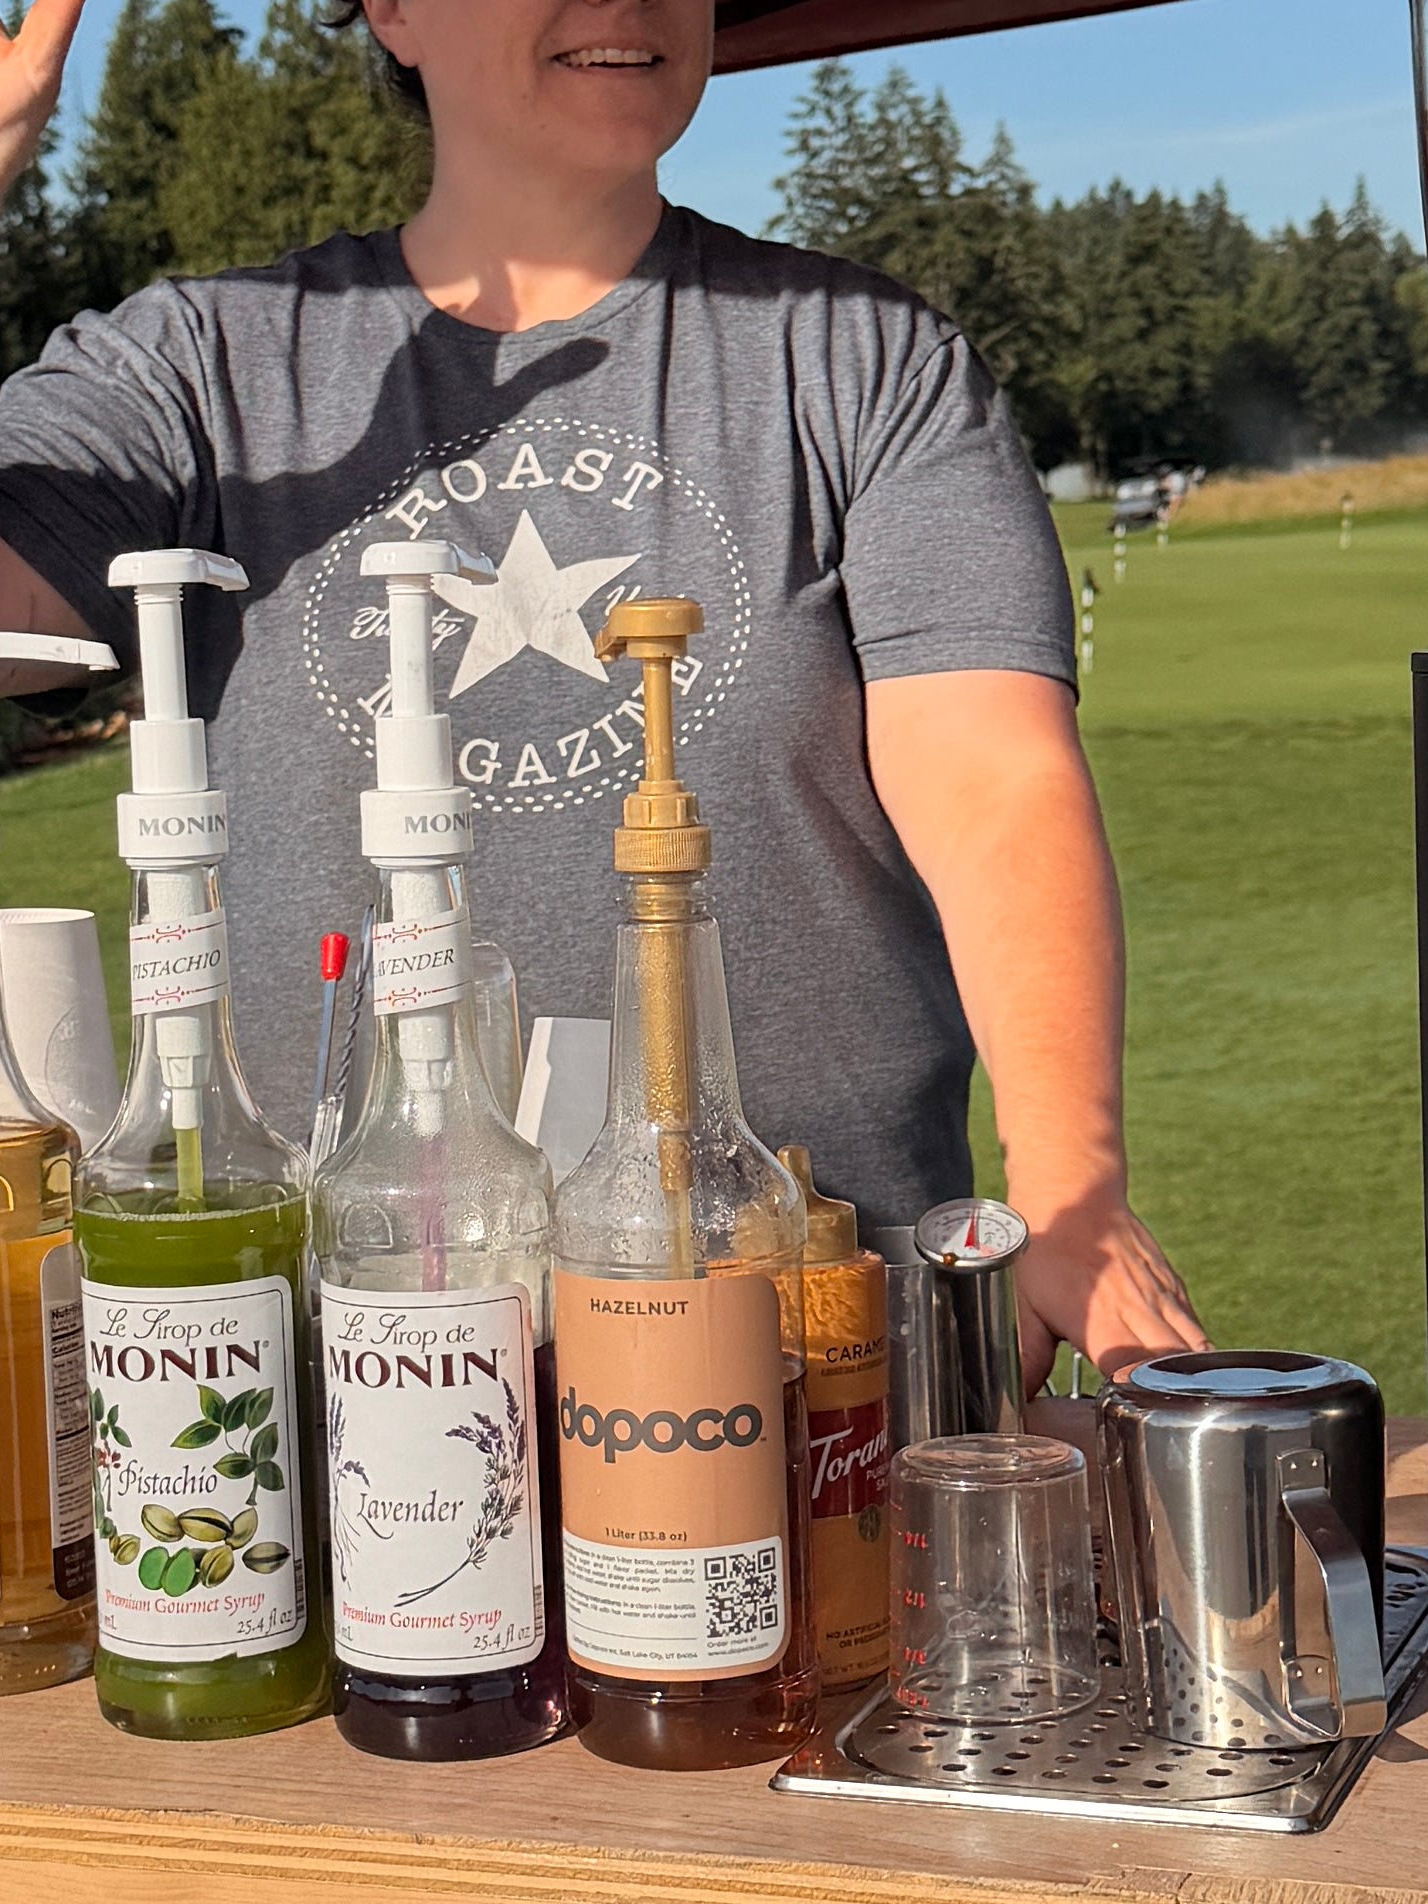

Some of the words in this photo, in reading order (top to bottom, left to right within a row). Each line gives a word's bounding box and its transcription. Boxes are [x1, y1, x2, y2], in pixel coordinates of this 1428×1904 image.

[386, 443, 664, 540] ROAST
[590, 1298, 689, 1316] HAZELNUT
[100, 1307, 126, 1339] Le
[133, 1307, 202, 1347] Sirop
[210, 1316, 239, 1337] de
[338, 1312, 363, 1342] Le
[370, 1313, 437, 1353] Sirop
[446, 1323, 475, 1343] de
[90, 1339, 261, 1382] MONIN
[329, 1345, 499, 1388] MONIN
[560, 1385, 763, 1464] dopoco
[117, 1459, 218, 1498] Pistachio
[357, 1489, 464, 1540] Lavender
[605, 1527, 610, 1537] 1
[611, 1528, 636, 1540] Liter
[639, 1531, 666, 1541] (33.8
[669, 1532, 688, 1542] oz)
[105, 1588, 151, 1612] Premium
[155, 1597, 220, 1615] Gourmet
[224, 1591, 265, 1615] Syrup
[342, 1600, 386, 1625] Premium
[391, 1611, 454, 1629] Gourmet
[459, 1608, 502, 1633] Syrup
[236, 1618, 265, 1635] 25.4
[266, 1608, 278, 1636] fl
[279, 1610, 293, 1625] oz
[473, 1633, 501, 1651] 25.4
[503, 1623, 516, 1651] fl
[517, 1625, 531, 1639] oz
